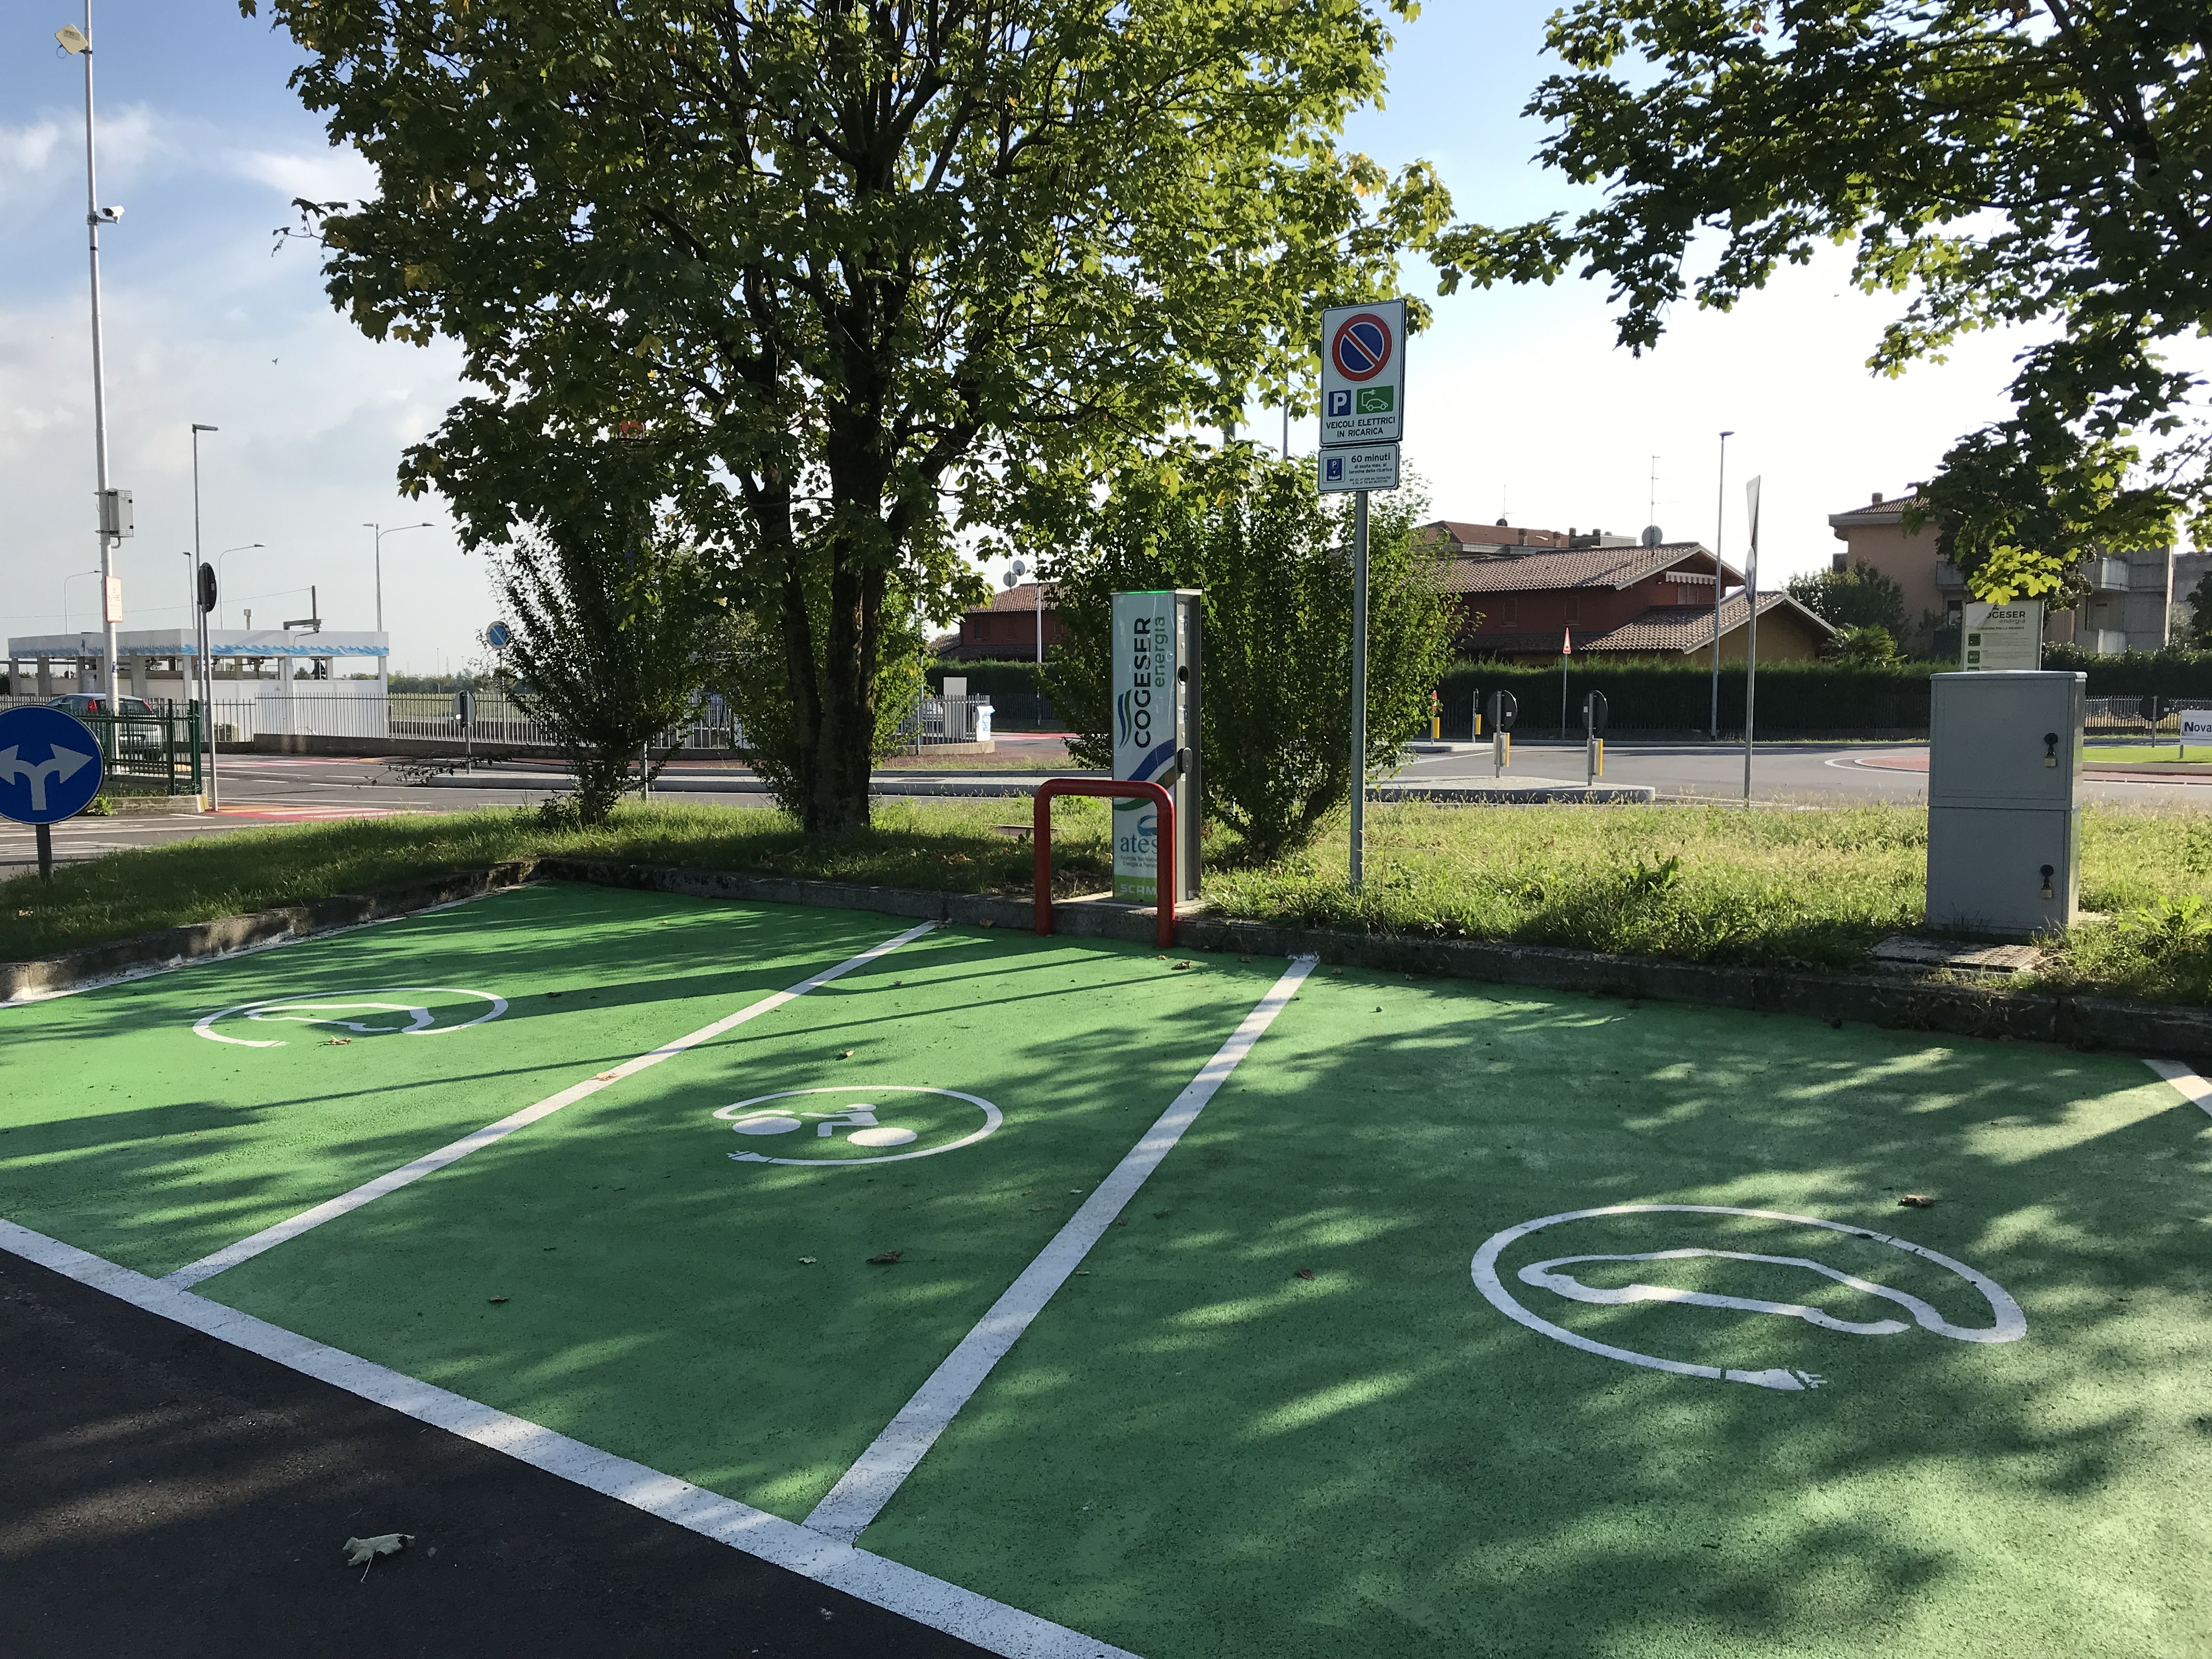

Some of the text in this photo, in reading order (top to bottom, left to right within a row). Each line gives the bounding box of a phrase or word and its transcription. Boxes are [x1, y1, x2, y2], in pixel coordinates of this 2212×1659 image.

[1333, 392, 1347, 414] P
[1326, 416, 1396, 430] VEICOLI ELETTRICI
[1348, 427, 1384, 437] RICARICA
[1351, 453, 1391, 463] 60 minuti
[1155, 617, 1168, 687] energia
[1134, 618, 1151, 748] COGESER
[2184, 721, 2212, 732] Nova
